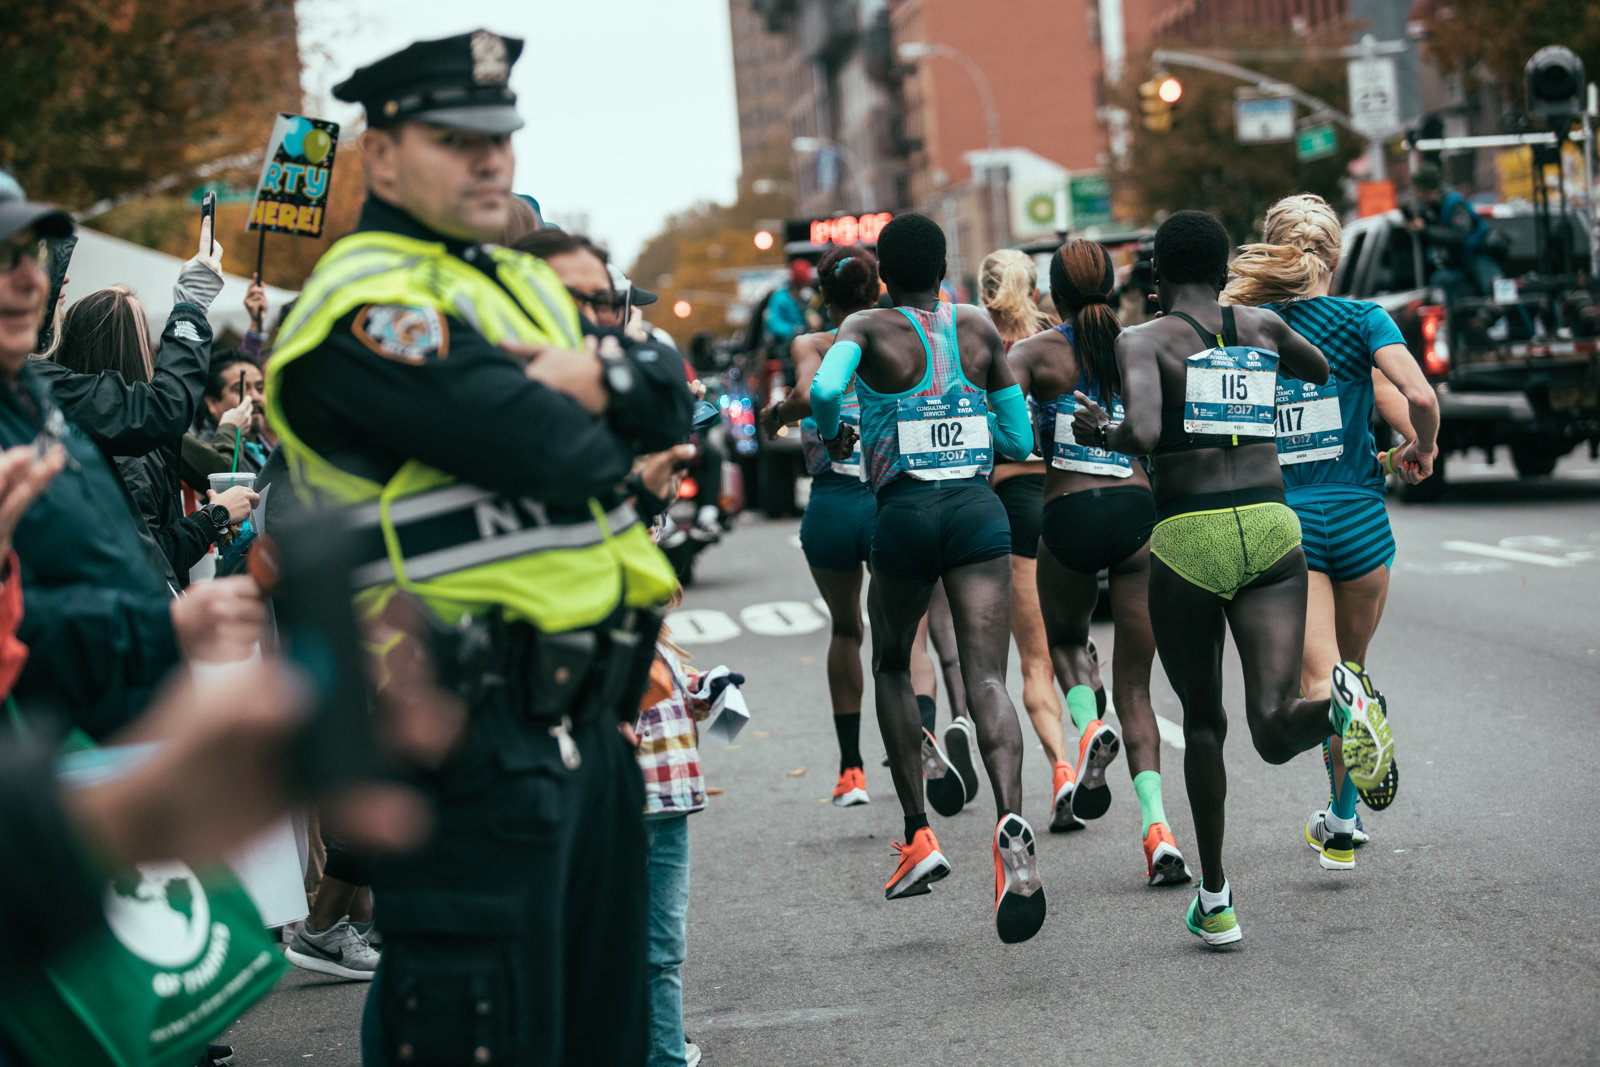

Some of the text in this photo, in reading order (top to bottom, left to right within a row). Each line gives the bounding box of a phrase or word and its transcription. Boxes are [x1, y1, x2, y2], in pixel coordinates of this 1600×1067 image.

[262, 162, 327, 198] RTY
[251, 200, 322, 234] HERE!
[1222, 374, 1248, 400] 115
[1227, 404, 1253, 414] 2017
[1278, 406, 1304, 432] 117
[930, 422, 964, 448] 102
[1285, 433, 1312, 446] 2017
[940, 450, 966, 460] 2017
[1088, 447, 1112, 458] 2017
